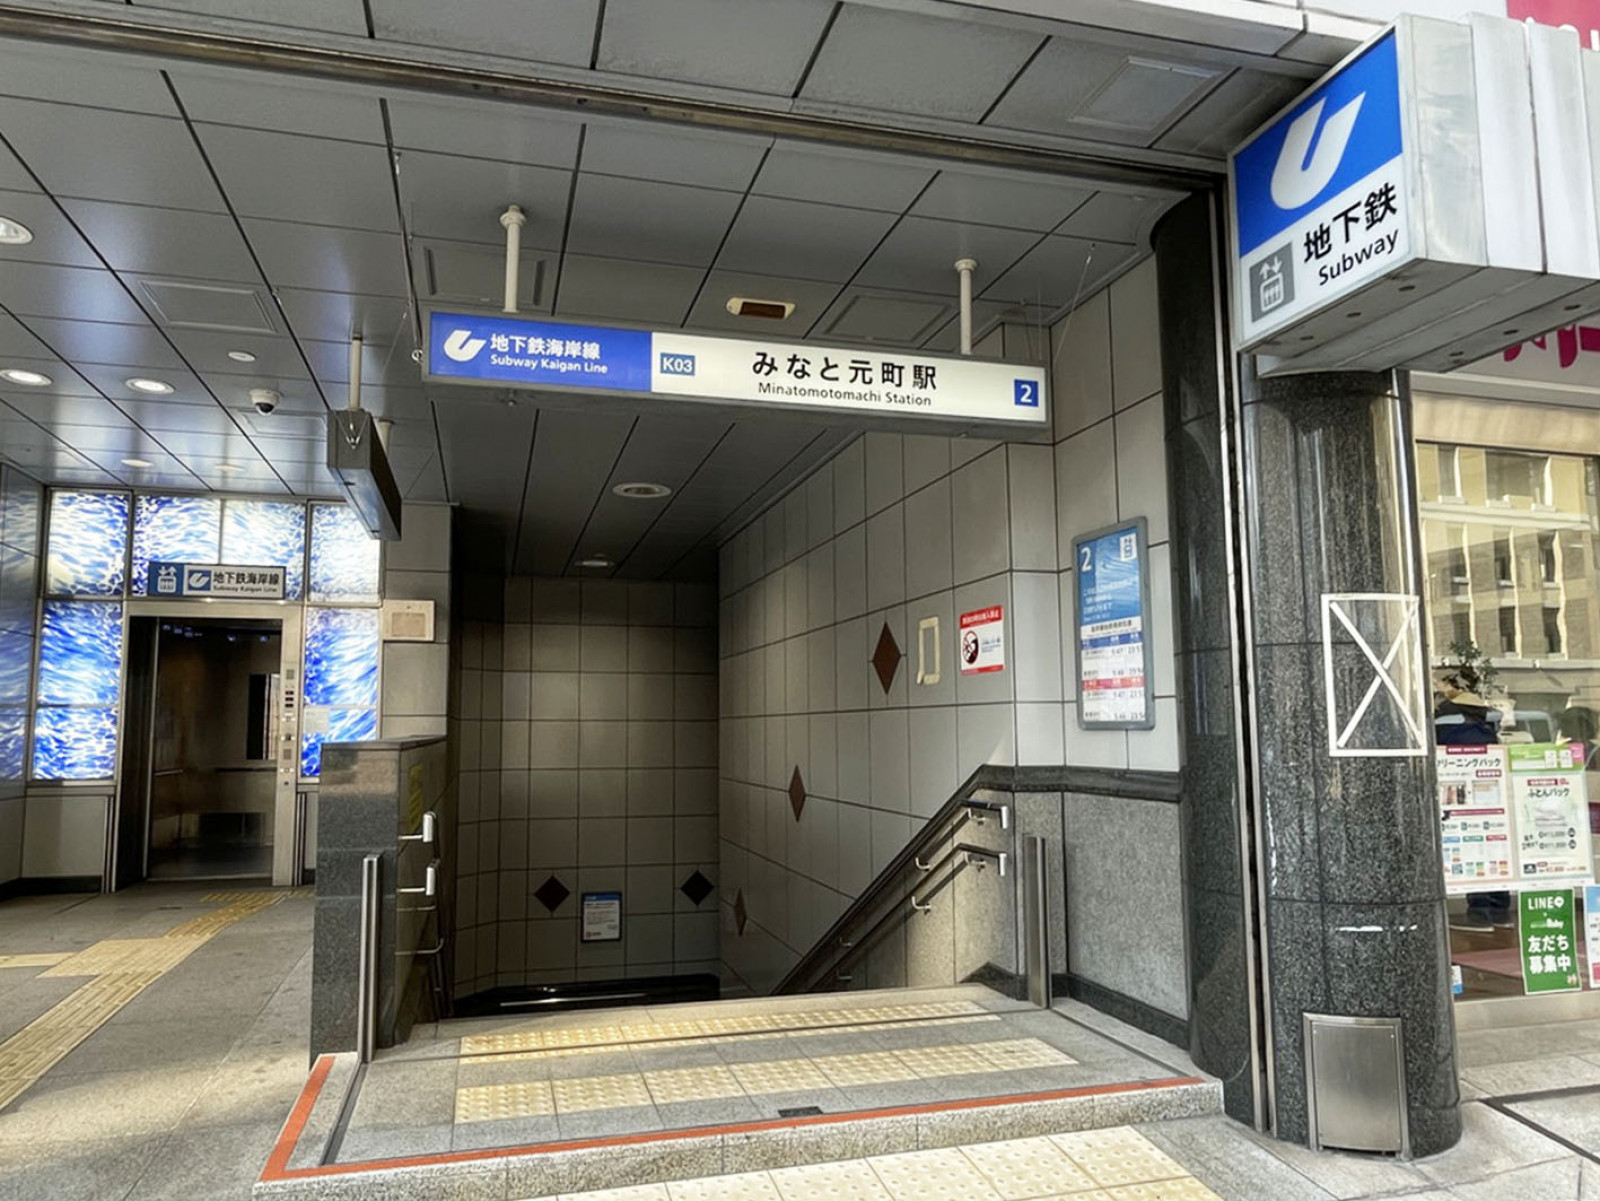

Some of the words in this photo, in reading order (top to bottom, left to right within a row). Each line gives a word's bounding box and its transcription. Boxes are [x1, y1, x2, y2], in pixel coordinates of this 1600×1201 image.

[1303, 182, 1397, 263] 地下鉄
[1318, 229, 1399, 286] Subway
[490, 333, 601, 360] 地下鉄海岸線
[490, 354, 538, 371] Subway
[541, 359, 582, 373] Kaigan
[583, 362, 608, 374] Line
[662, 357, 693, 374] K03
[752, 351, 937, 390] みなと元町駅
[758, 382, 882, 402] Minatomotomachi
[884, 391, 932, 406] Station
[1020, 384, 1033, 403] 2
[1081, 546, 1092, 572] 2
[213, 571, 279, 585] 地下鉄海岸線
[1527, 896, 1554, 911] LINE
[1527, 933, 1570, 953] 友だち
